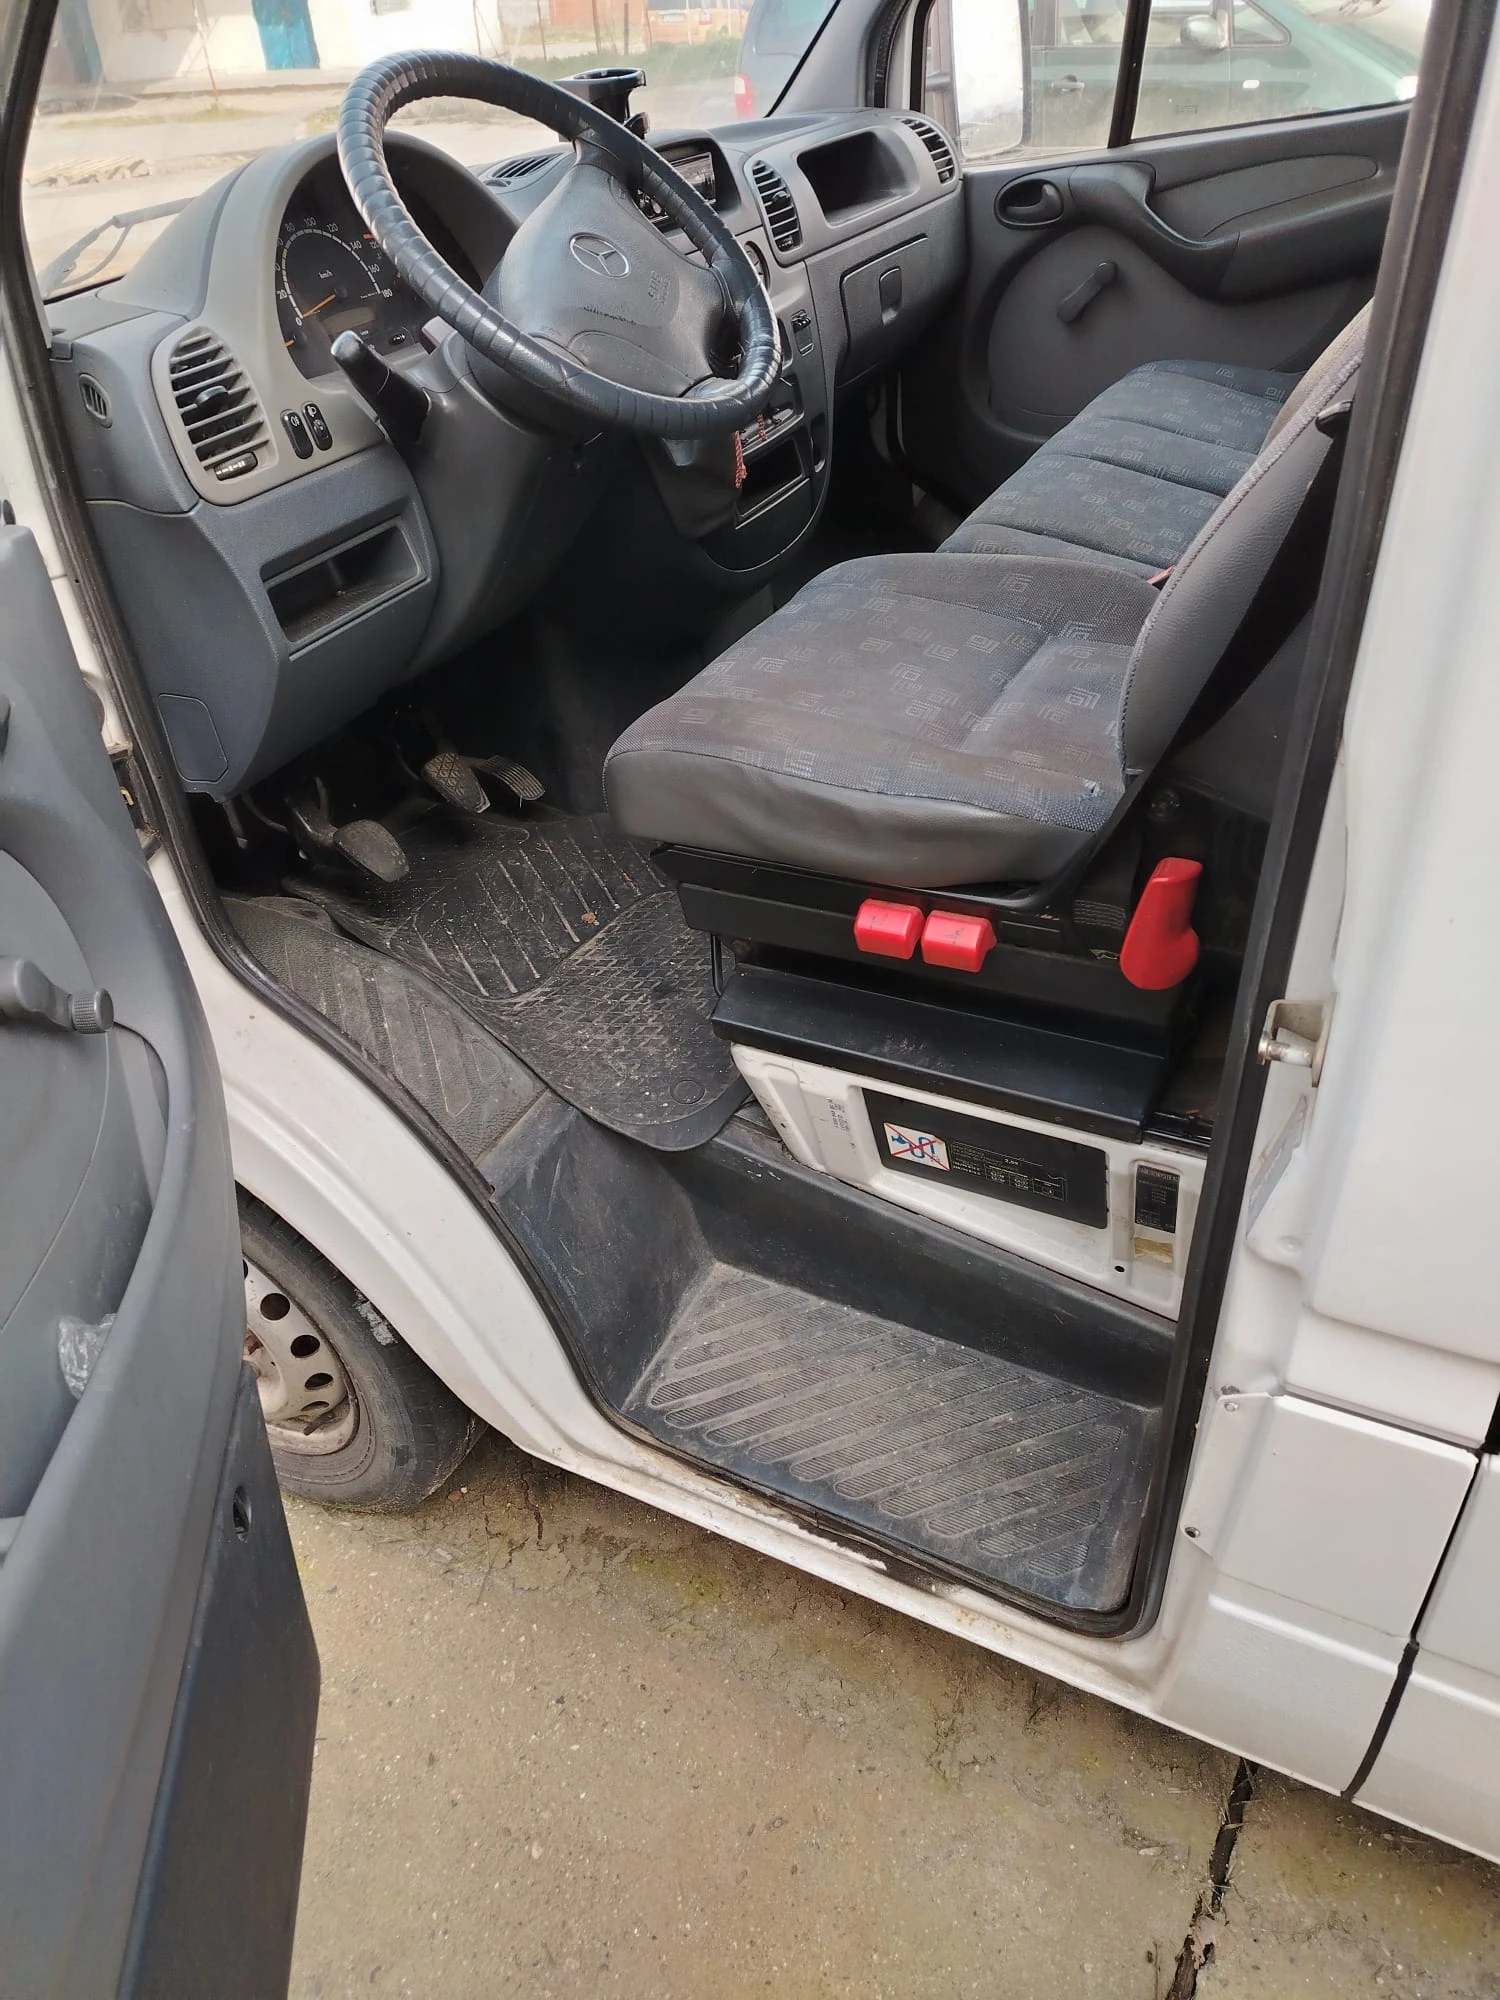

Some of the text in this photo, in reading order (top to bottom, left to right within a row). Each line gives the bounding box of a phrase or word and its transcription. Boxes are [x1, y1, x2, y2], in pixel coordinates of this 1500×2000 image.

[304, 217, 317, 227] 100
[326, 223, 339, 233] 120
[350, 240, 362, 250] 140
[368, 263, 380, 273] 160
[276, 289, 288, 300] 20
[381, 288, 393, 299] 180
[295, 316, 303, 326] 0
